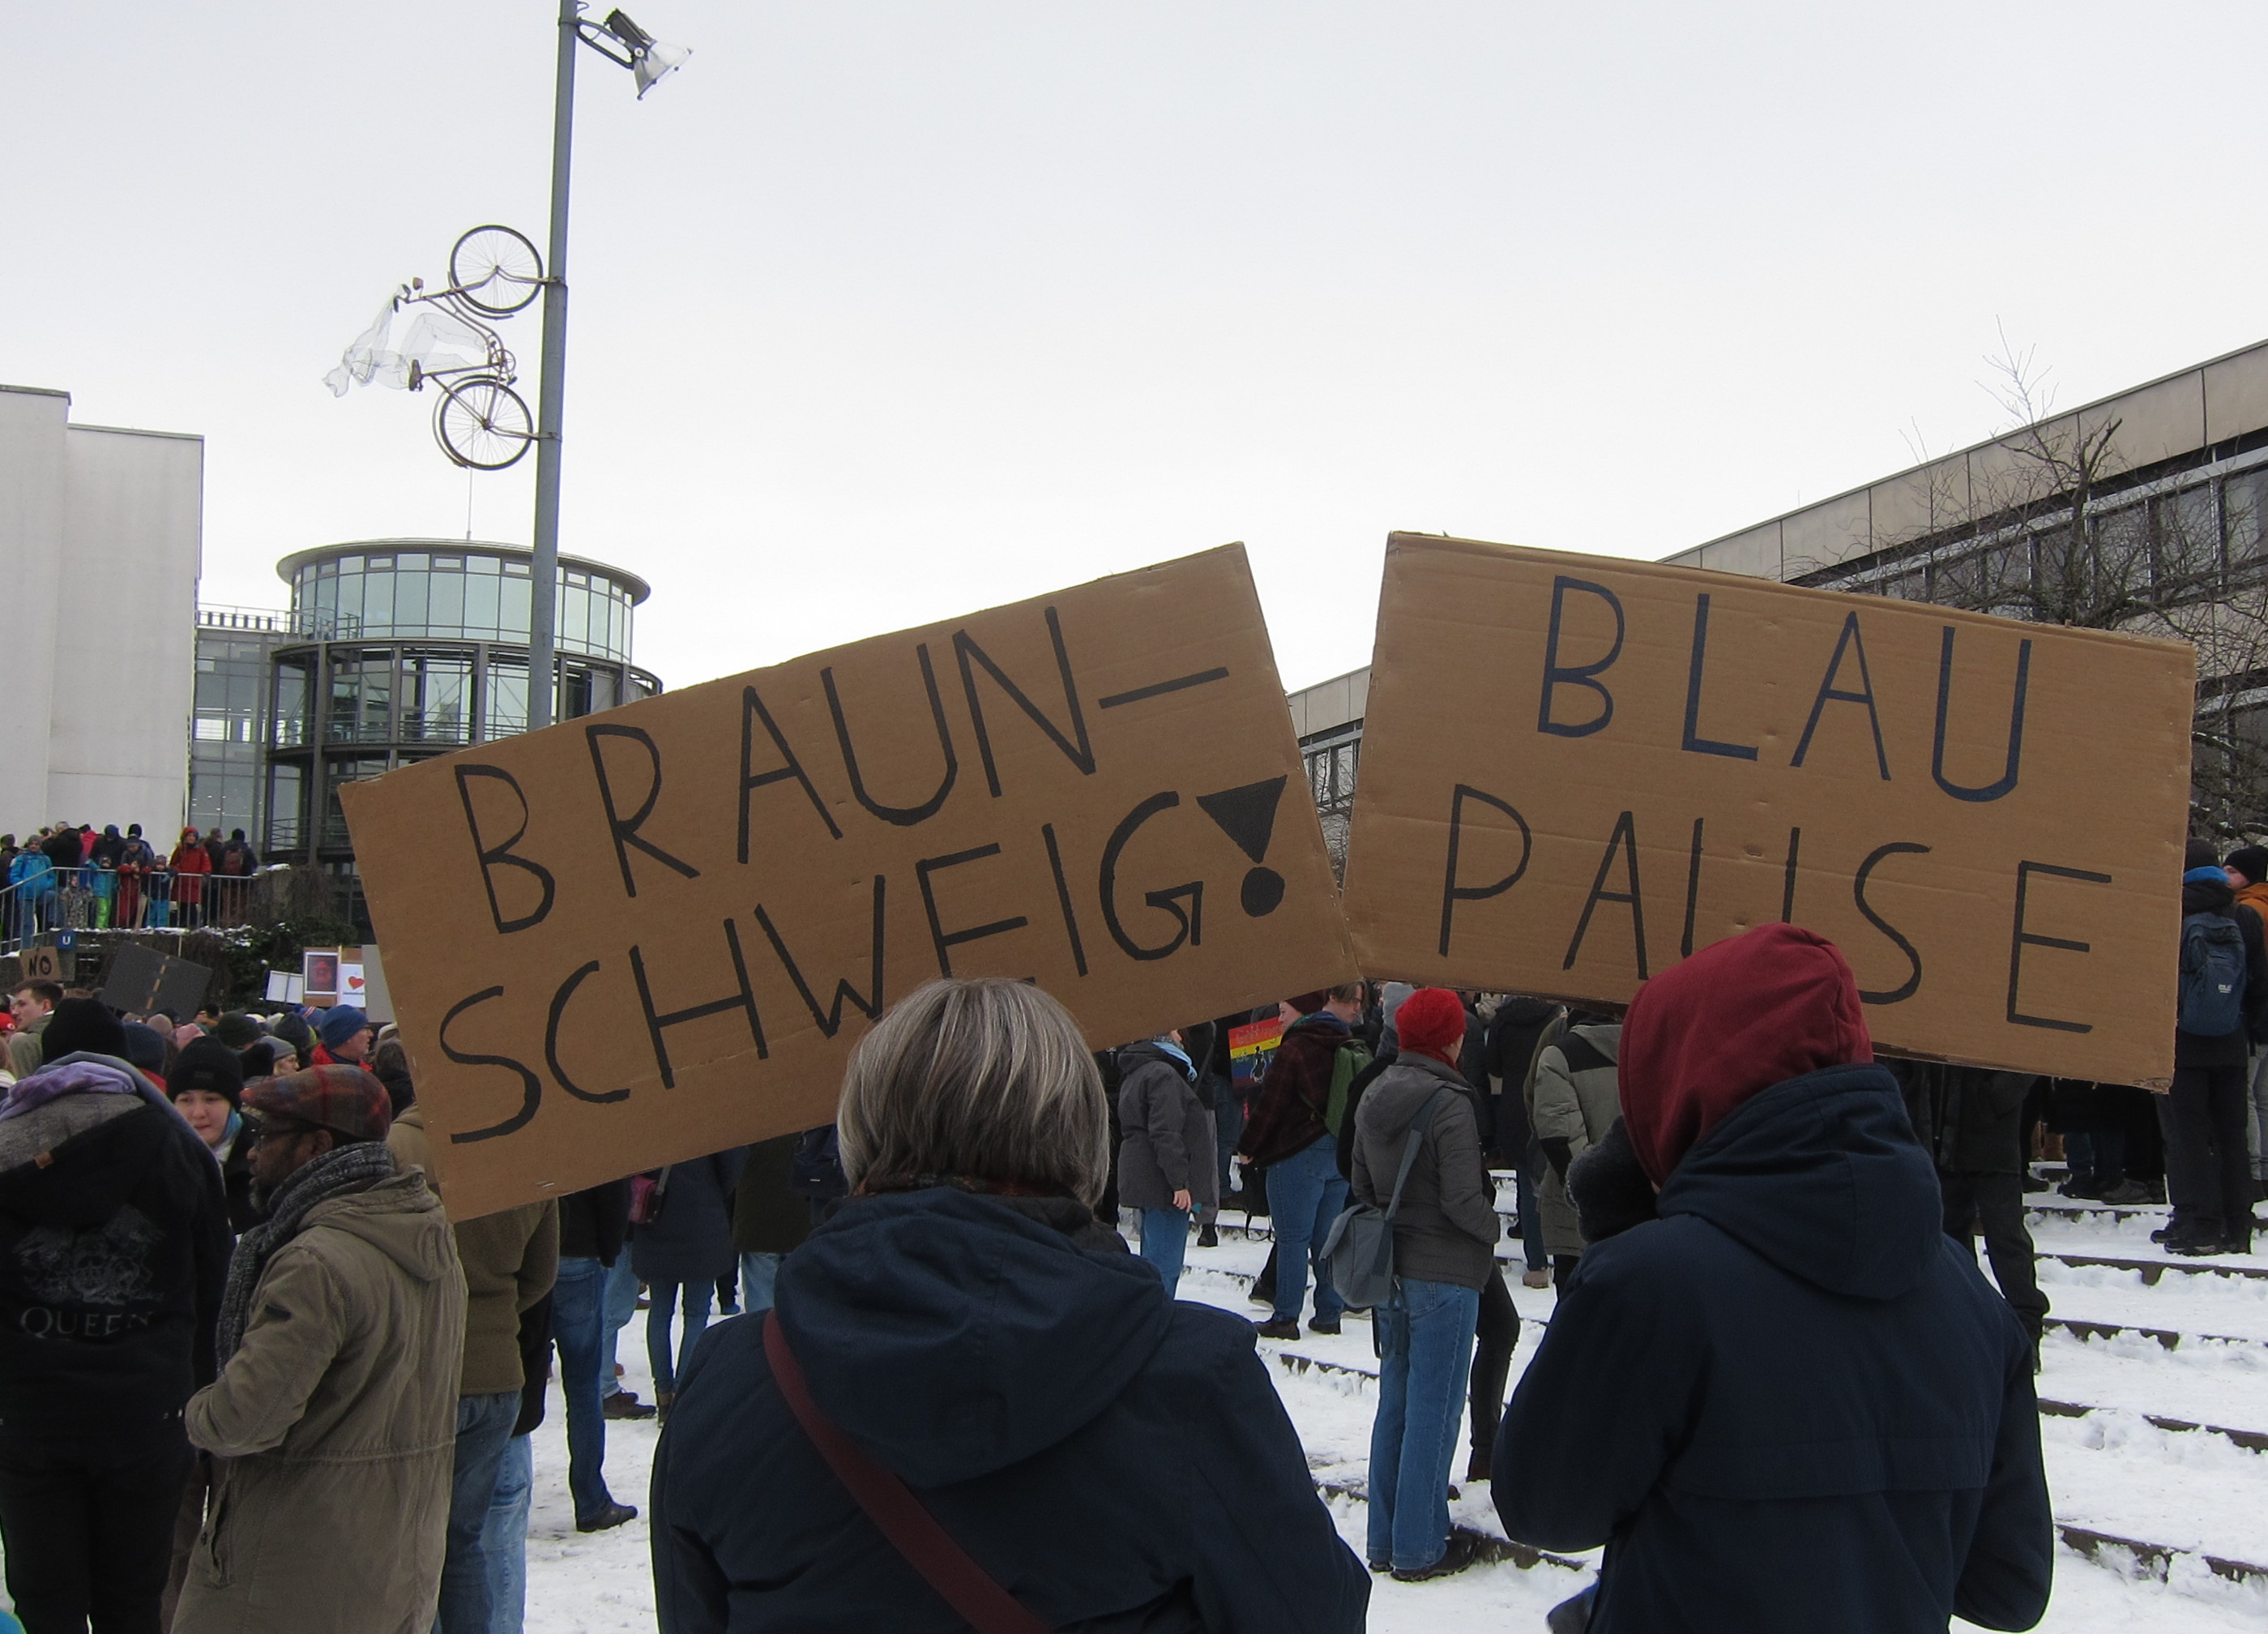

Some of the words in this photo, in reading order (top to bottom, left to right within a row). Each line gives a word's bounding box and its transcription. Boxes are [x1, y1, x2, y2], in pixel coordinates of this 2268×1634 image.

[1537, 575, 2032, 802] BLAU
[454, 605, 1229, 935] BRAUN-
[62, 935, 71, 945] U
[28, 955, 52, 977] NO
[20, 1306, 154, 1338] QUEEN
